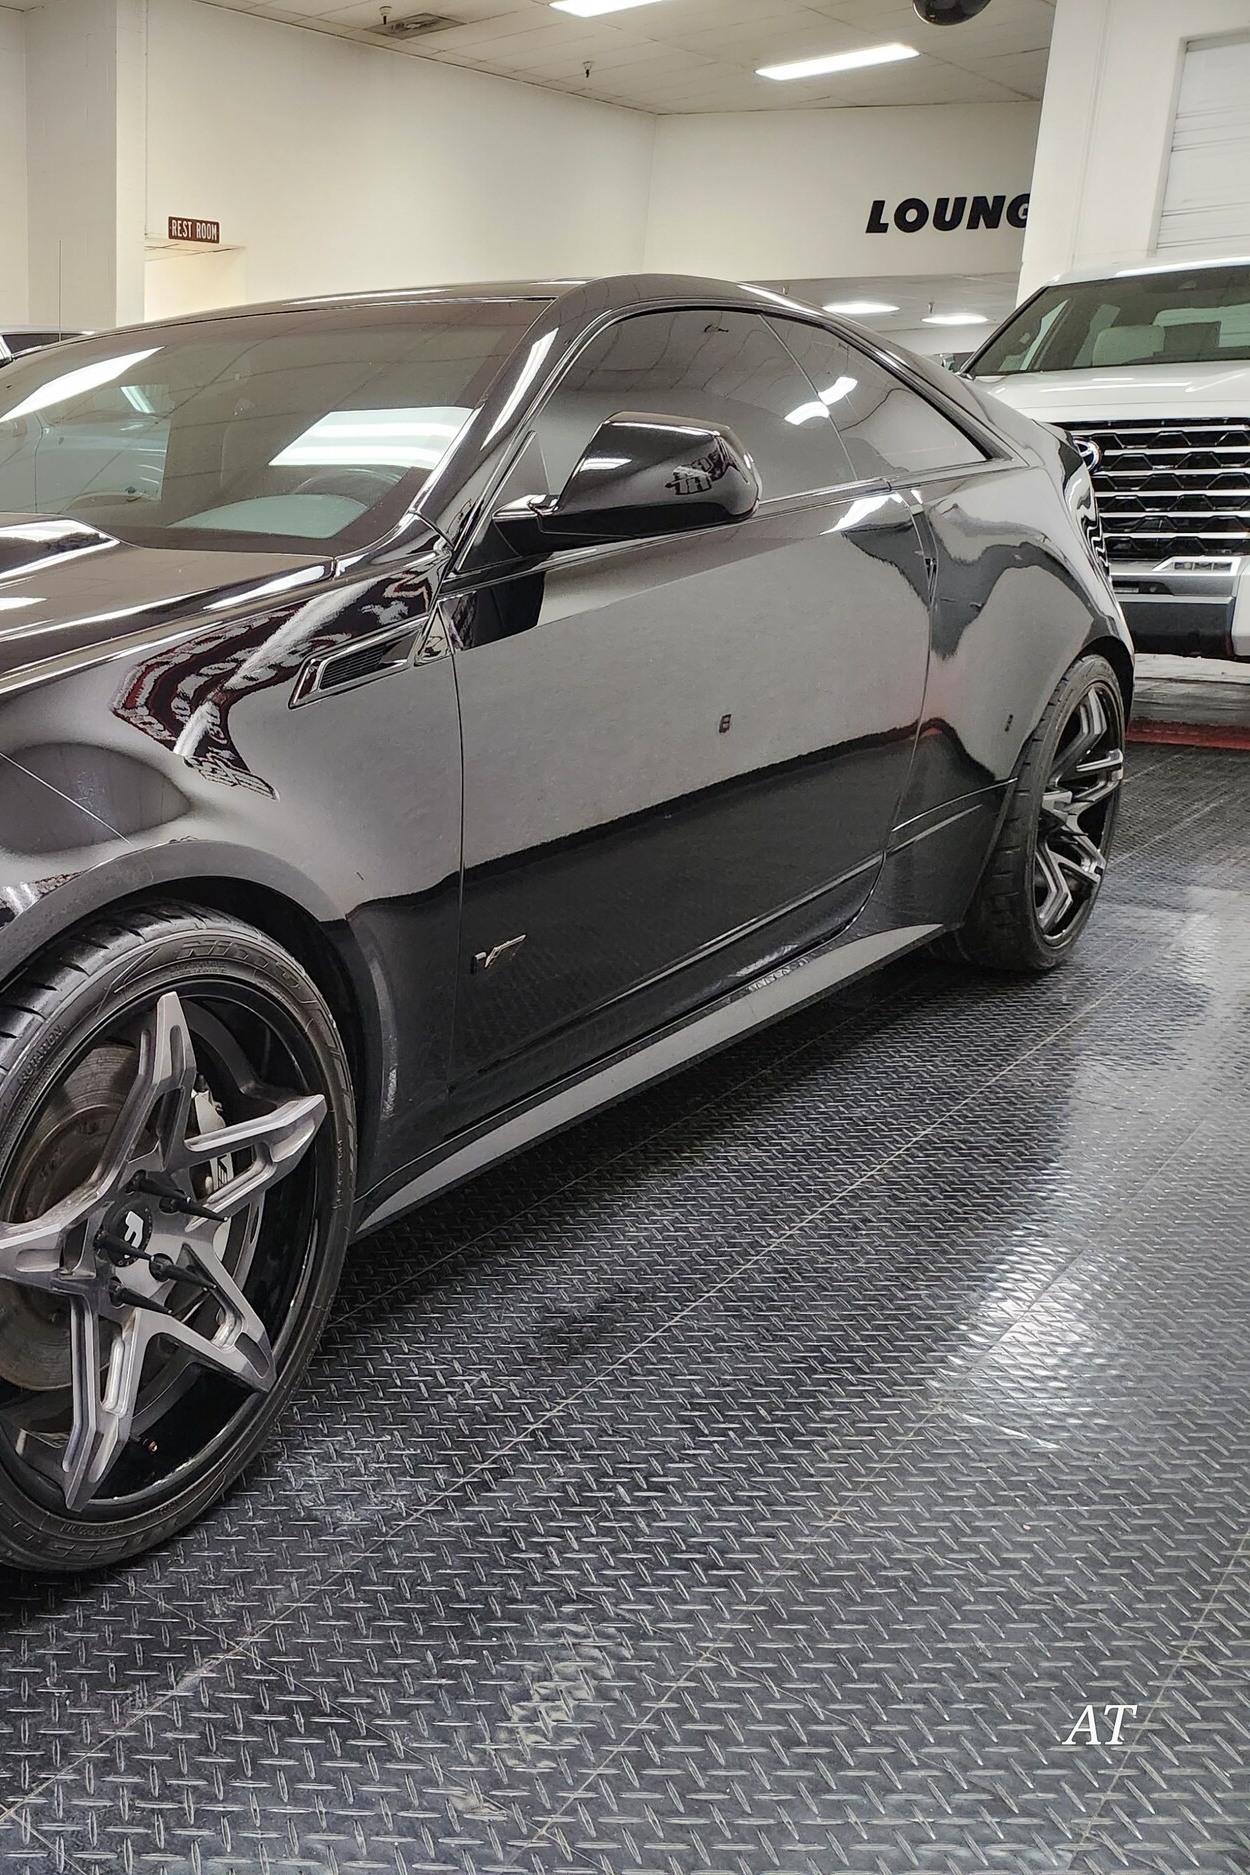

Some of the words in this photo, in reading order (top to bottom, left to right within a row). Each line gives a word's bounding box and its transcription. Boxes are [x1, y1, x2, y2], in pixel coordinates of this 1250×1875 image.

[865, 193, 1031, 233] LOUNG
[171, 219, 192, 238] REST
[196, 222, 217, 241] ROOM
